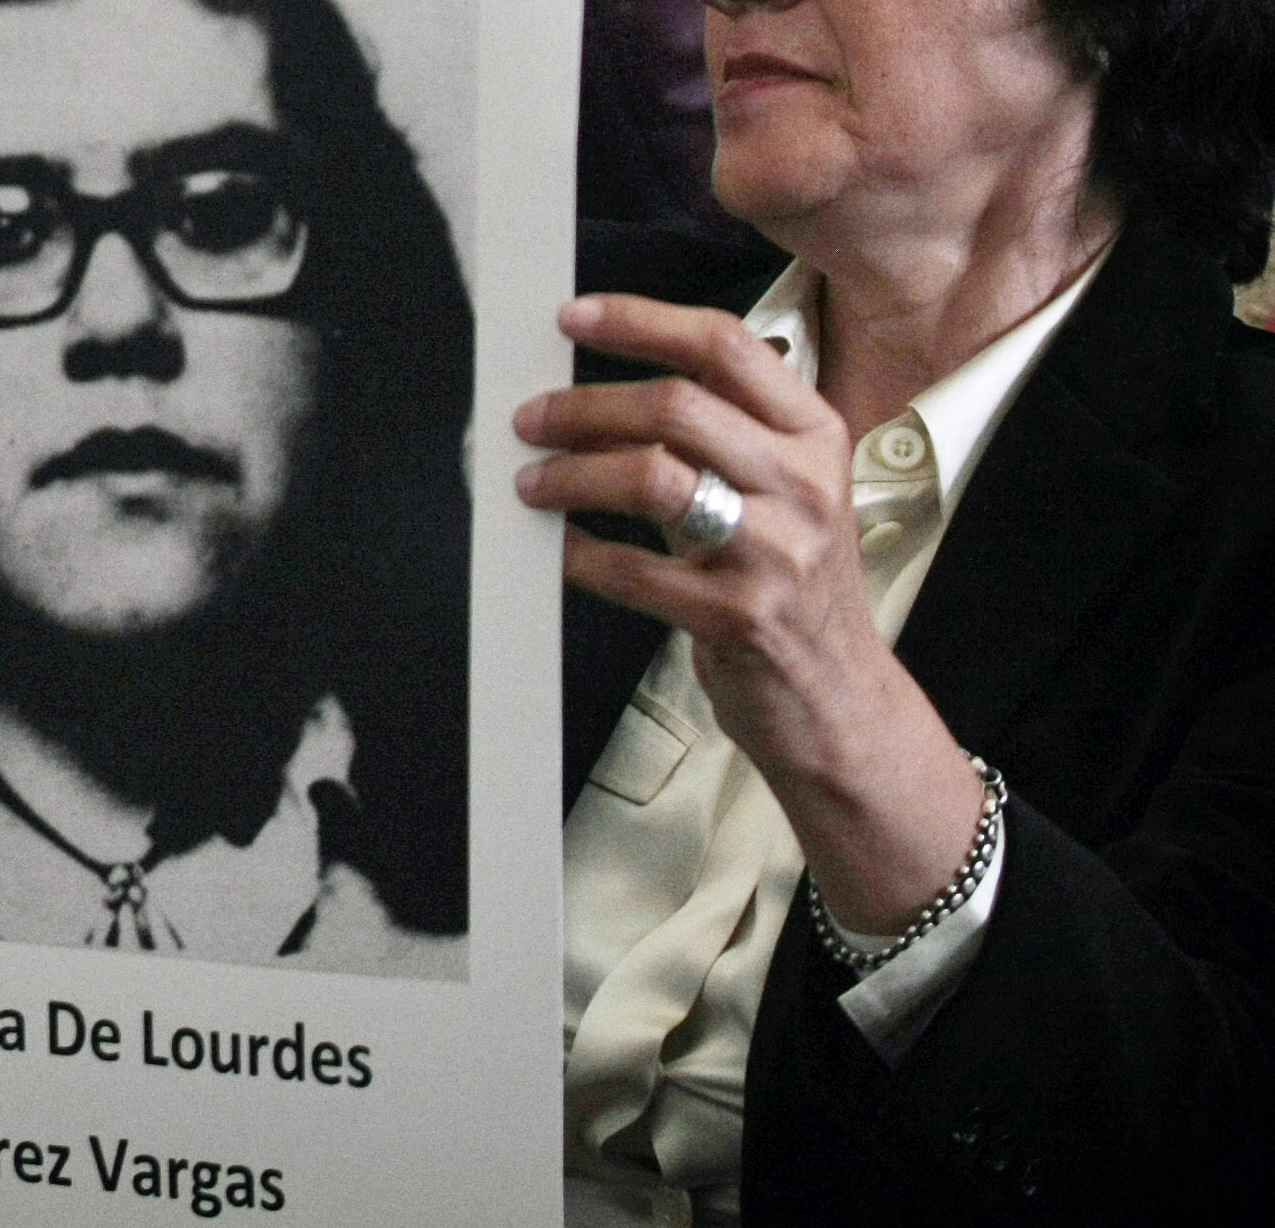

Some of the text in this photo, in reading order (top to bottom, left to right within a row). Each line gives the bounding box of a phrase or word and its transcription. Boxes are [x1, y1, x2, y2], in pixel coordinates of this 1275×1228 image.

[48, 1000, 121, 1062] De
[143, 1010, 373, 1089] Lourdes
[88, 1135, 285, 1219] Vargas
